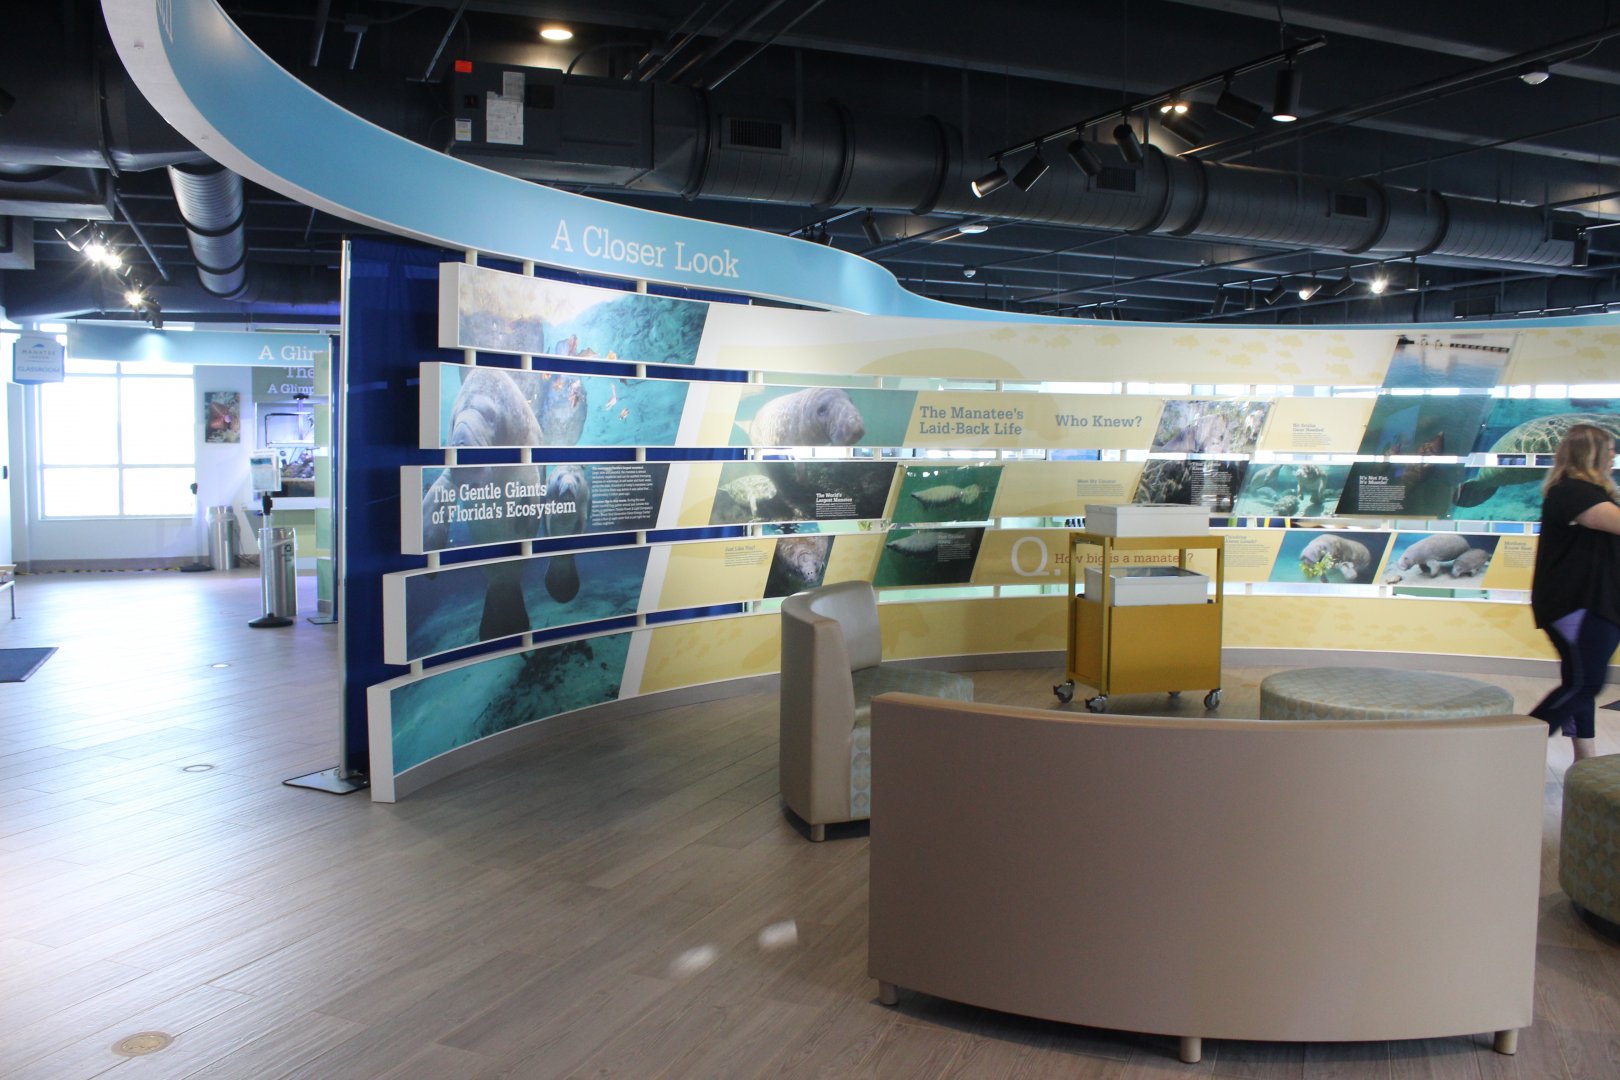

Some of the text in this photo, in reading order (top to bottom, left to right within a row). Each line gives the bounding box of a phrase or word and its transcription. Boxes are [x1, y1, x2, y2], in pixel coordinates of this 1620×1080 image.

[551, 219, 739, 278] A Closer Look
[258, 345, 275, 360] A
[267, 384, 278, 394] A
[920, 406, 1024, 420] The Manatee's
[1055, 414, 1142, 427] Who Knew?
[920, 422, 1022, 435] Laid-Back Life
[433, 481, 547, 503] The Gentle Giants
[432, 500, 577, 524] of Florida's Ecosystem
[1134, 552, 1194, 564] manate?
